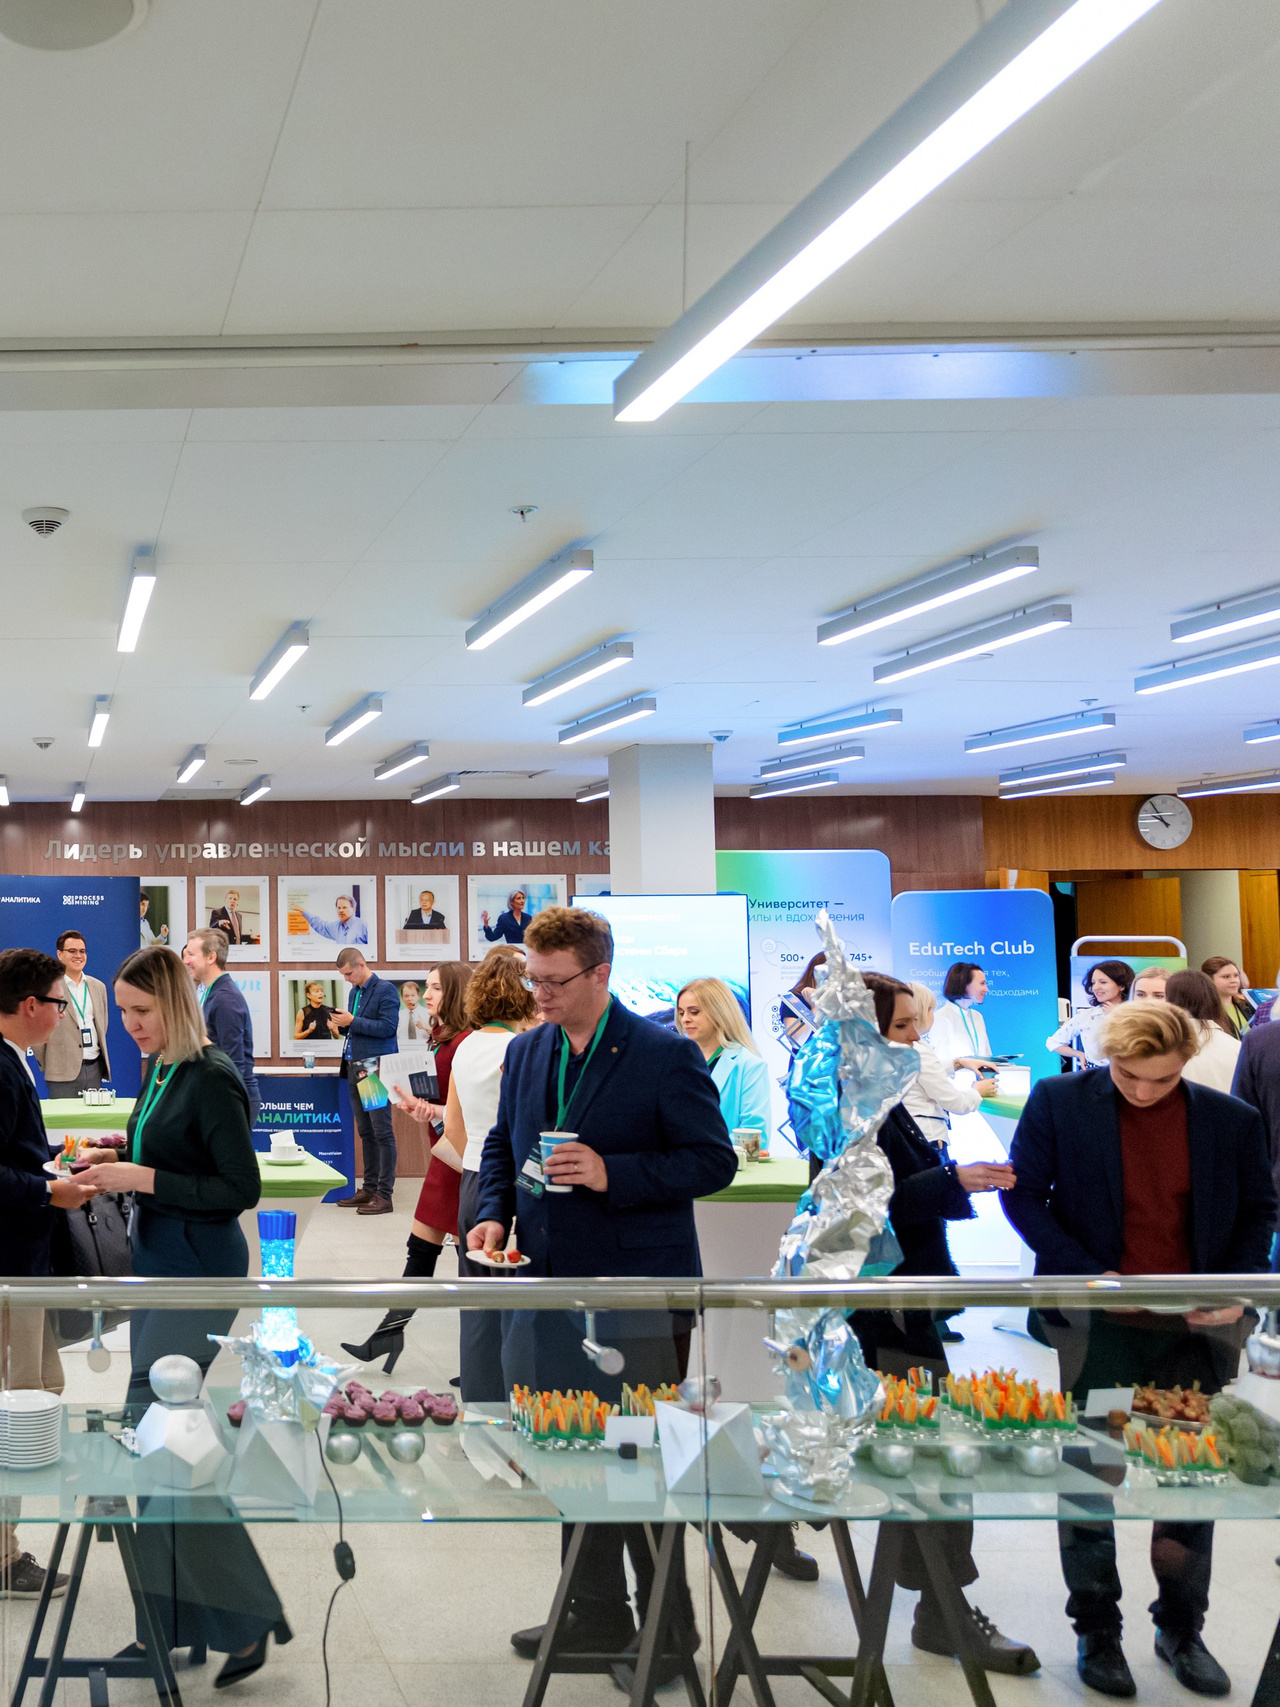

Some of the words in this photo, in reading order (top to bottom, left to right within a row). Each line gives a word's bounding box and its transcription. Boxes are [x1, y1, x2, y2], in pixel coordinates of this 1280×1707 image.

[44, 840, 147, 864] Лидеры
[156, 836, 370, 864] управленческой
[378, 841, 464, 857] мысли
[472, 841, 486, 857] в
[493, 840, 580, 857] нашем
[748, 898, 830, 910] Университет
[749, 913, 772, 922] илы
[775, 914, 783, 922] и
[786, 913, 865, 923] вдохвения
[909, 941, 985, 956] EduTech
[990, 939, 1035, 955] Club
[780, 953, 805, 962] 500+
[849, 953, 873, 962] 745+
[909, 968, 947, 978] Сообще
[991, 969, 1010, 977] тех,
[260, 1102, 292, 1111] ОЛЬШЕ
[293, 1102, 314, 1111] ЧЕМ
[256, 1112, 342, 1124] АНАЛИТИКА
